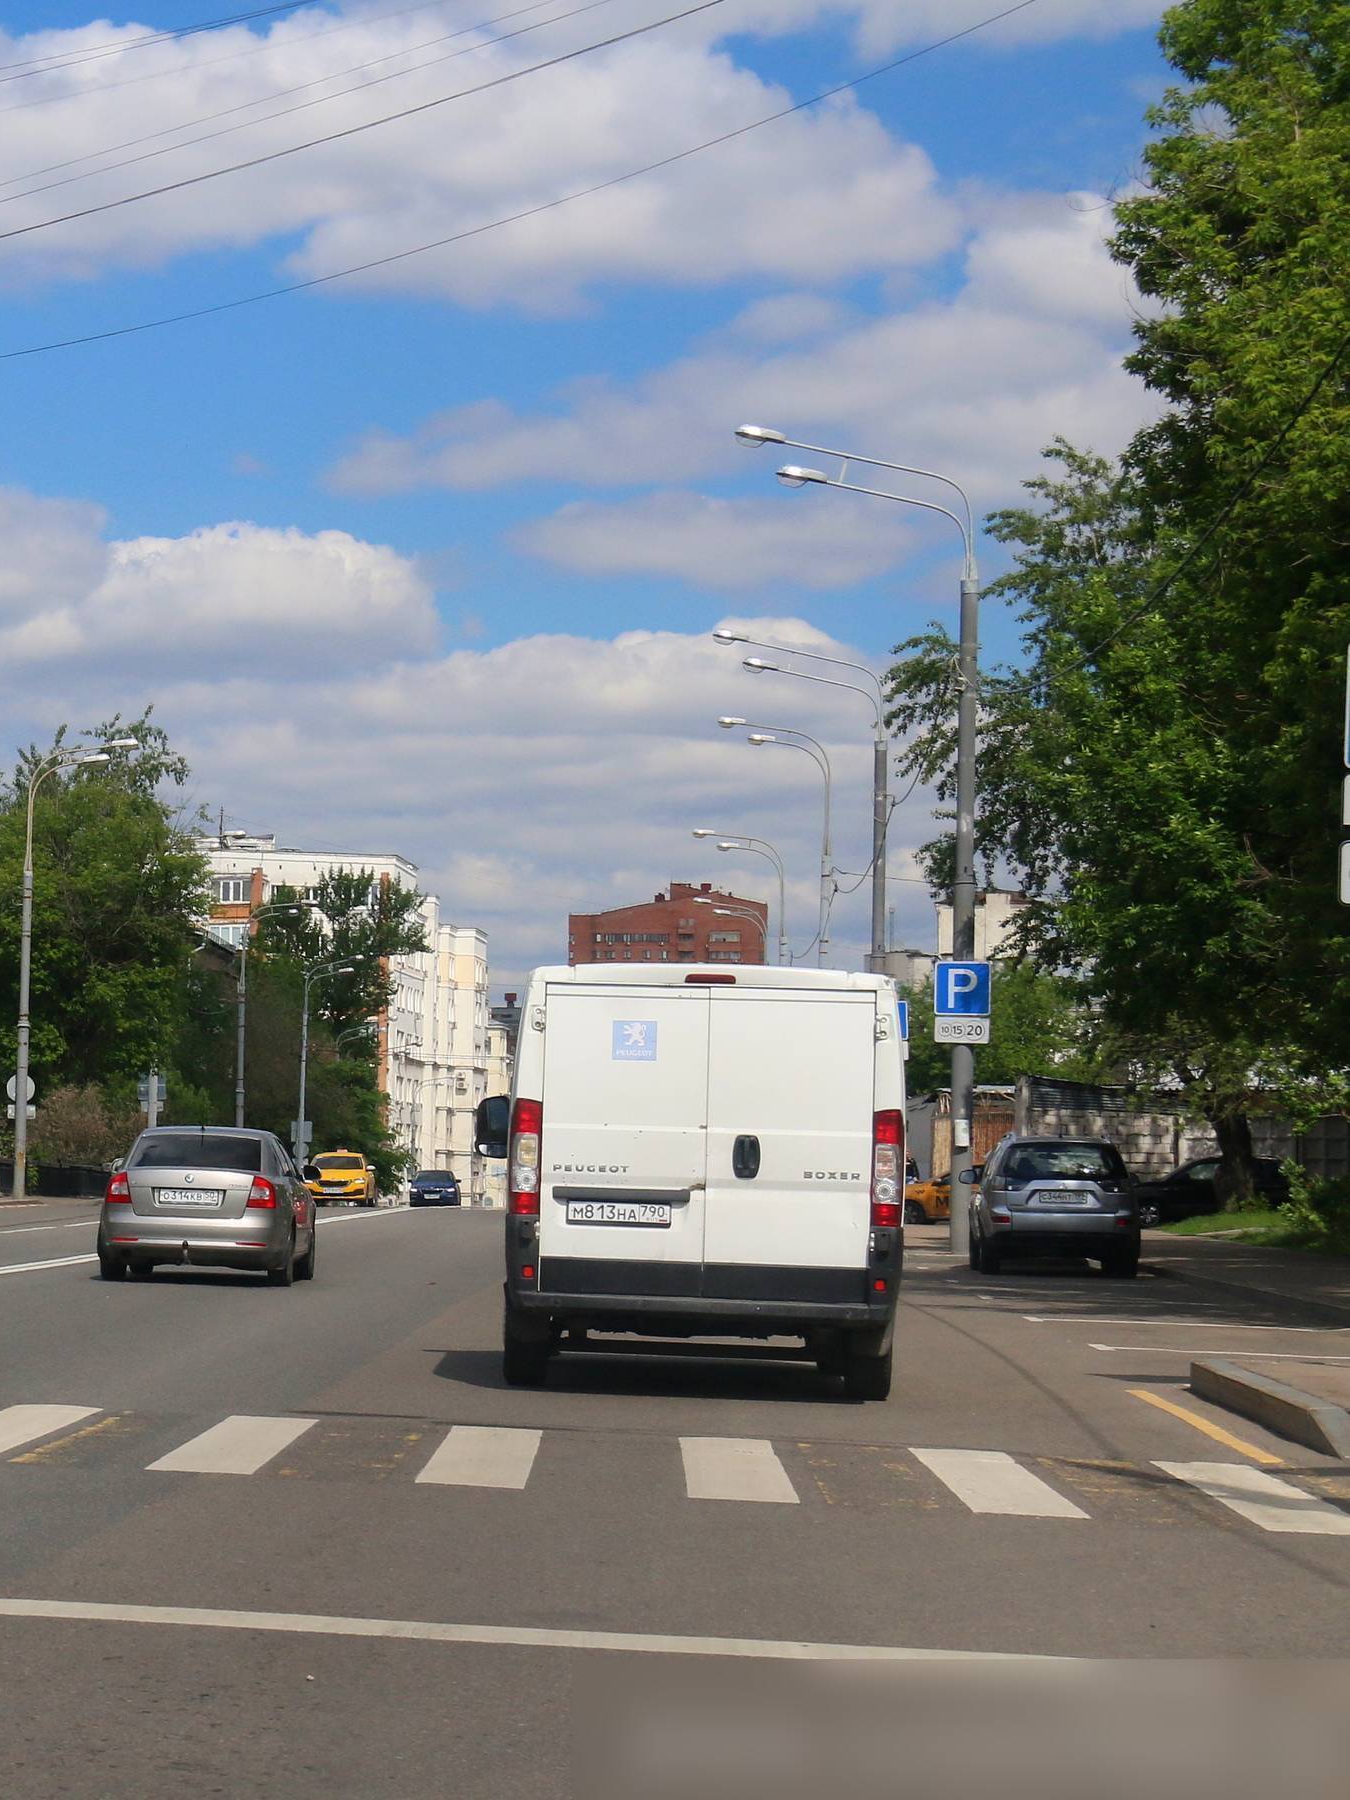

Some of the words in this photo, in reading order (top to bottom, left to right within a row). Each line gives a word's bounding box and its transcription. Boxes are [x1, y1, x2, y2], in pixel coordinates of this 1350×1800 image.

[947, 968, 978, 1009] P
[941, 1026, 950, 1034] 10
[953, 1025, 963, 1035] 15
[966, 1025, 983, 1036] 20
[553, 1163, 629, 1174] PEUGEOT
[803, 1171, 861, 1181] BOXER
[641, 1205, 665, 1218] 790
